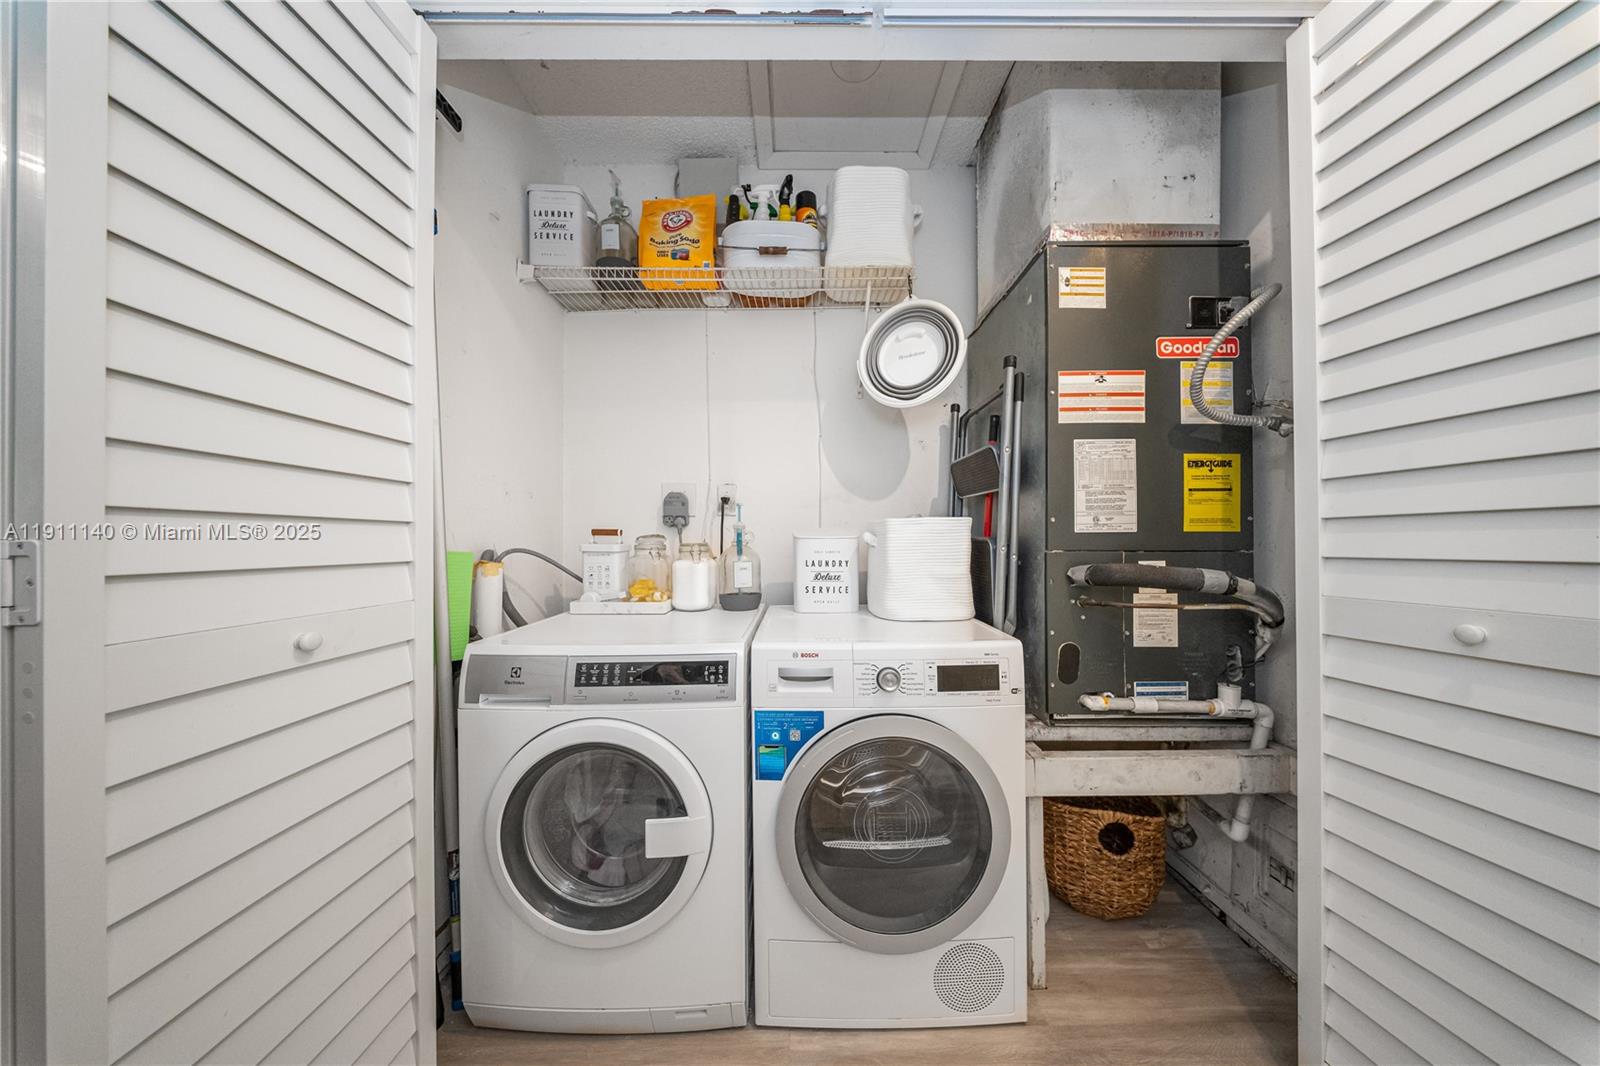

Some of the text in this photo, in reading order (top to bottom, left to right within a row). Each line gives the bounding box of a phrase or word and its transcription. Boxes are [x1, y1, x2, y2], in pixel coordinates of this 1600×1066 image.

[533, 209, 574, 218] LAUNDRY
[540, 220, 567, 229] Deluxe
[533, 232, 574, 241] SERVICE
[649, 237, 679, 246] Baking
[679, 235, 700, 244] Soda
[1160, 341, 1236, 354] Goodan
[805, 559, 849, 568] LAUNDRY
[812, 572, 842, 581] Deluxe
[804, 585, 849, 594] SERVICE
